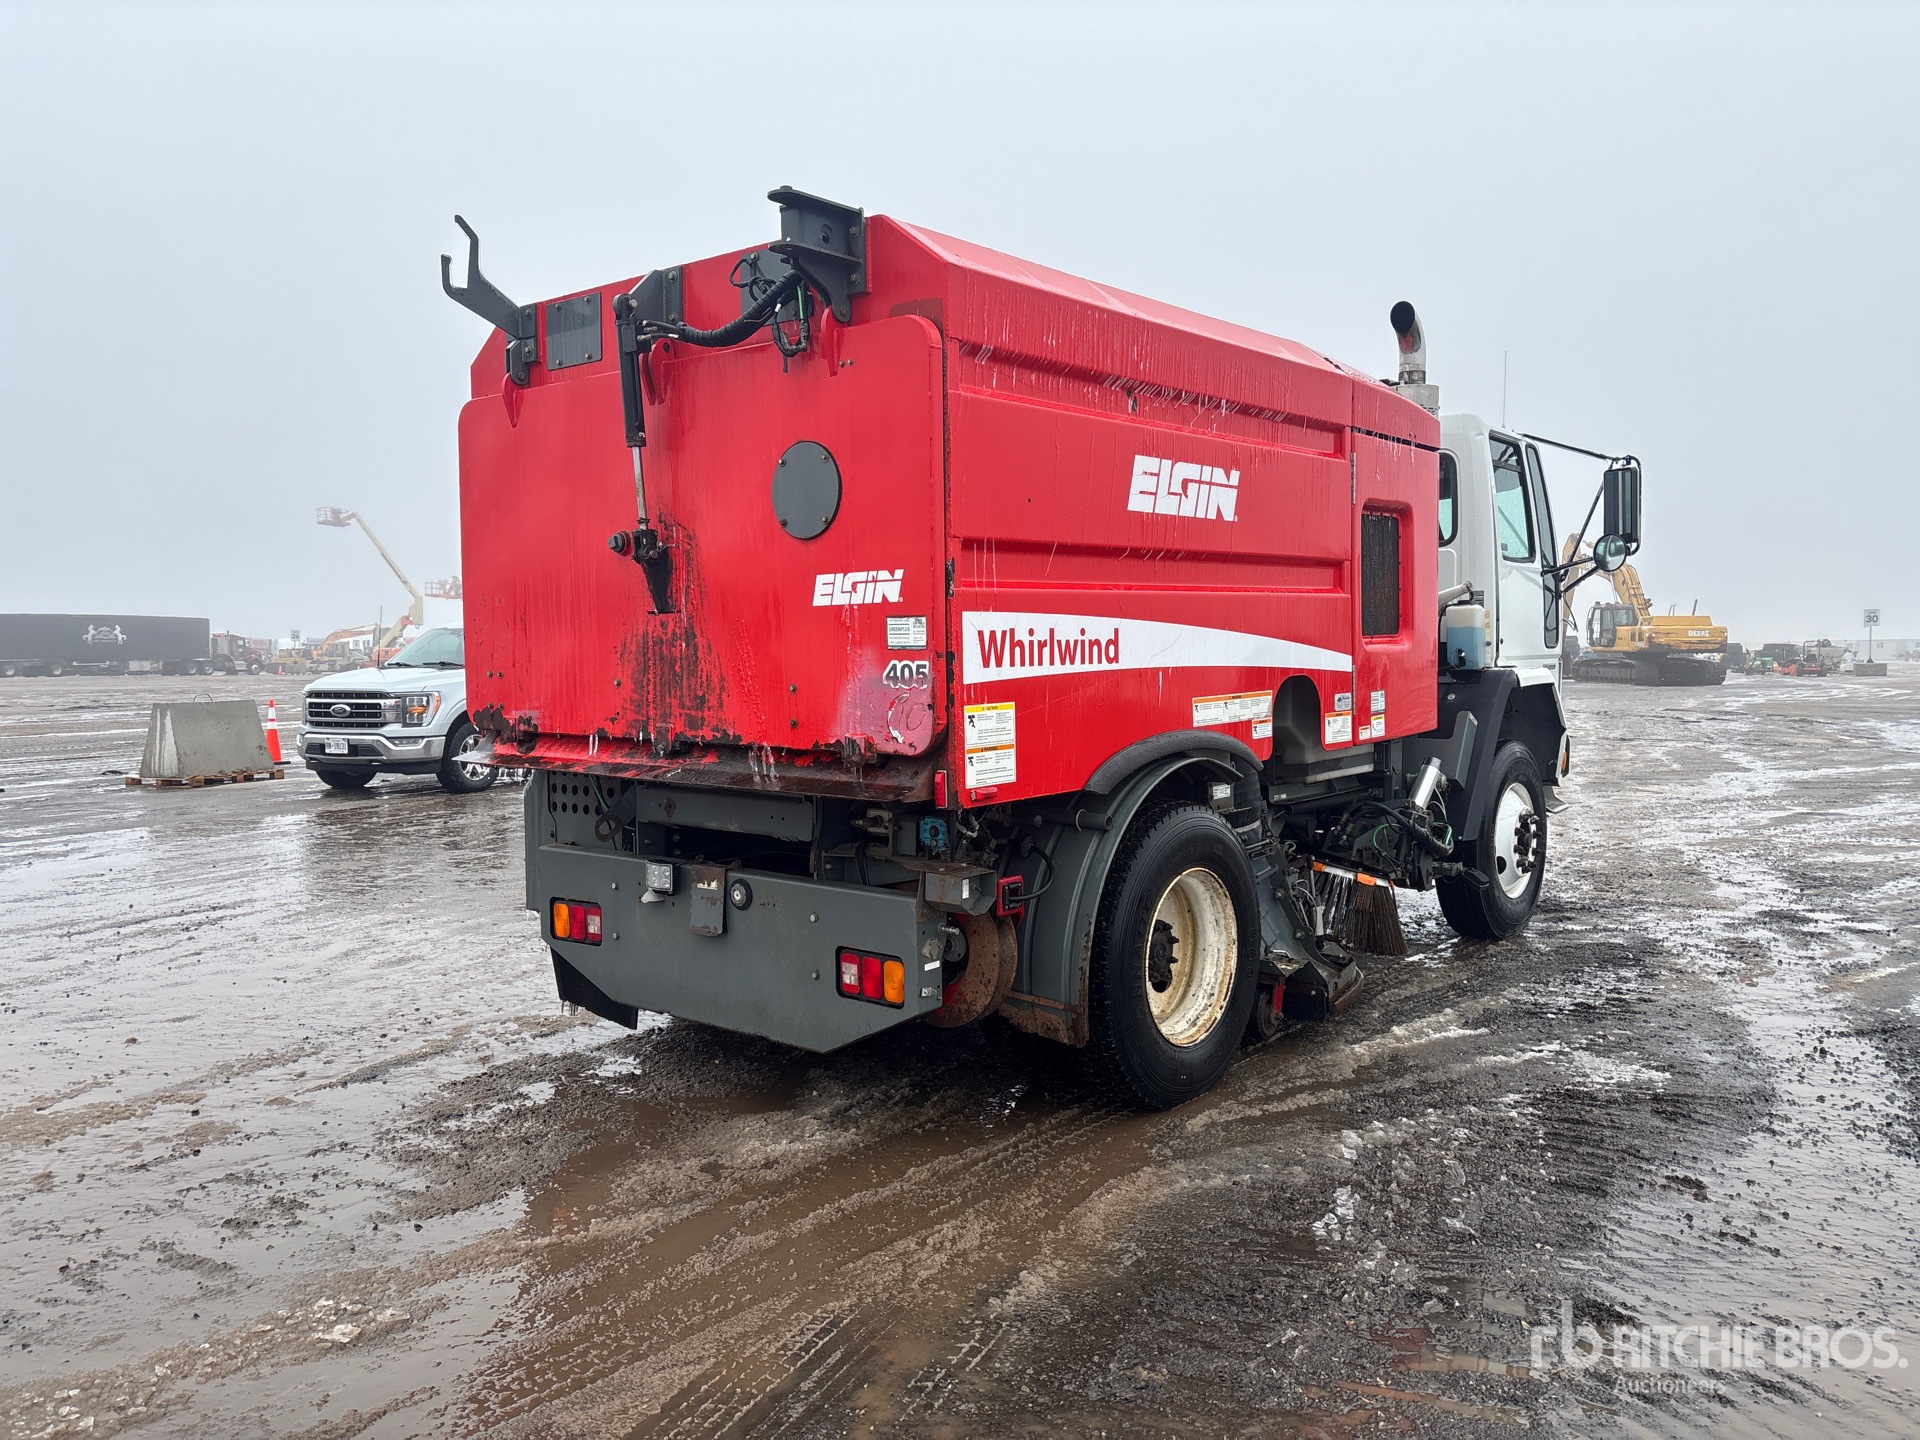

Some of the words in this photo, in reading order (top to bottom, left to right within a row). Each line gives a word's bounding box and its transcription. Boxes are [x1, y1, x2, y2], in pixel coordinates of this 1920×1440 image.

[1127, 455, 1240, 522] ELGIN
[812, 569, 904, 606] ELGIN
[1866, 615, 1878, 623] 30
[977, 627, 1119, 669] Whirlwind
[884, 661, 929, 686] 405
